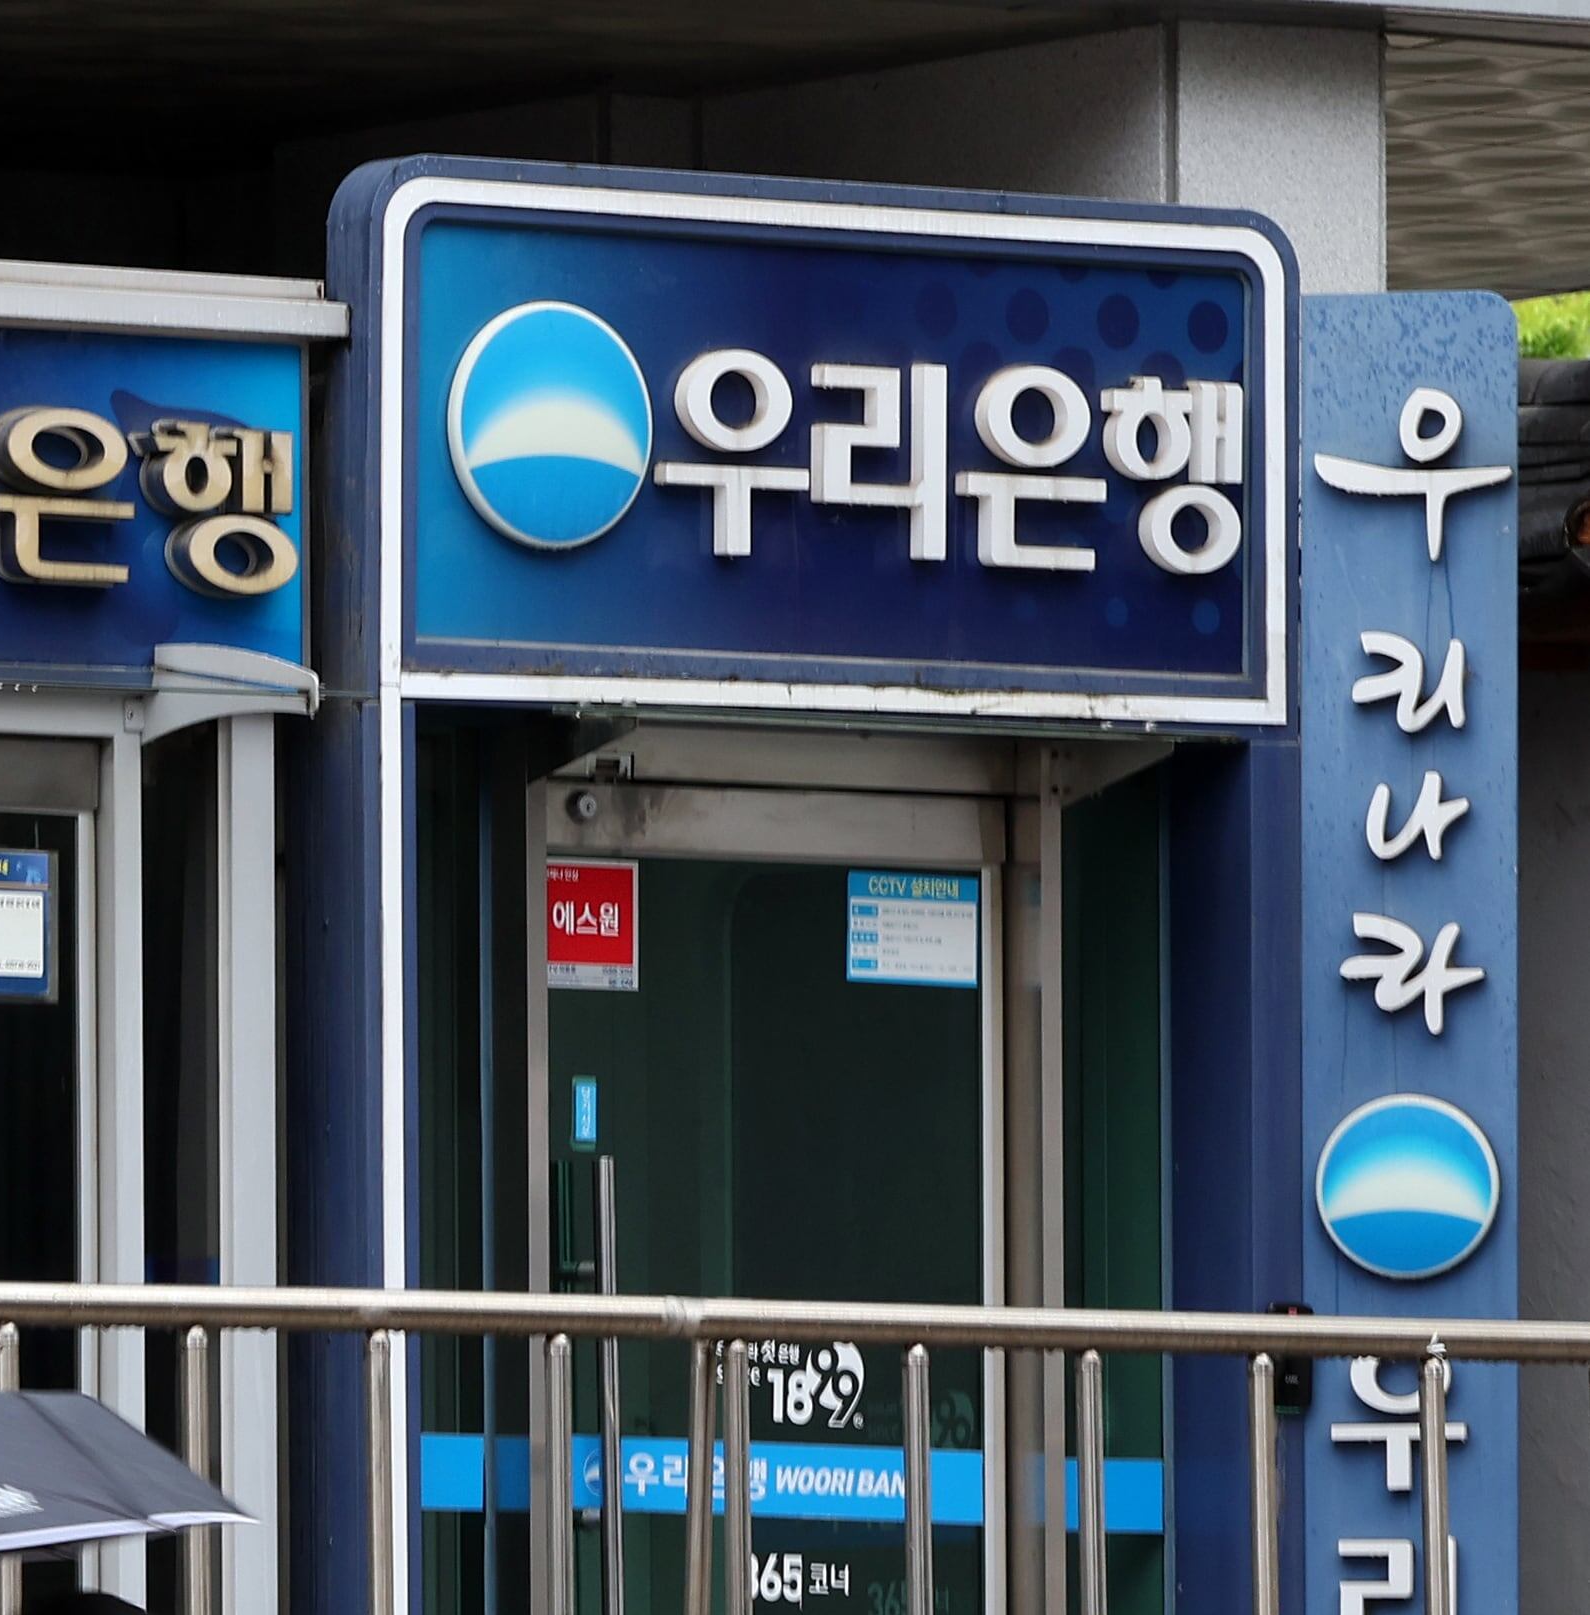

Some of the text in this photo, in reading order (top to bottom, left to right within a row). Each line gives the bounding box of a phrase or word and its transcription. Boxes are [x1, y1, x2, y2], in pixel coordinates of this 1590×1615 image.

[654, 348, 1244, 576] 우리은행
[1313, 387, 1513, 1036] 우리나라
[868, 875, 907, 896] CCTV
[552, 901, 619, 937] 에스원
[775, 1465, 853, 1497] WOORI
[857, 1469, 905, 1500] BAN
[808, 1562, 850, 1597] 코너
